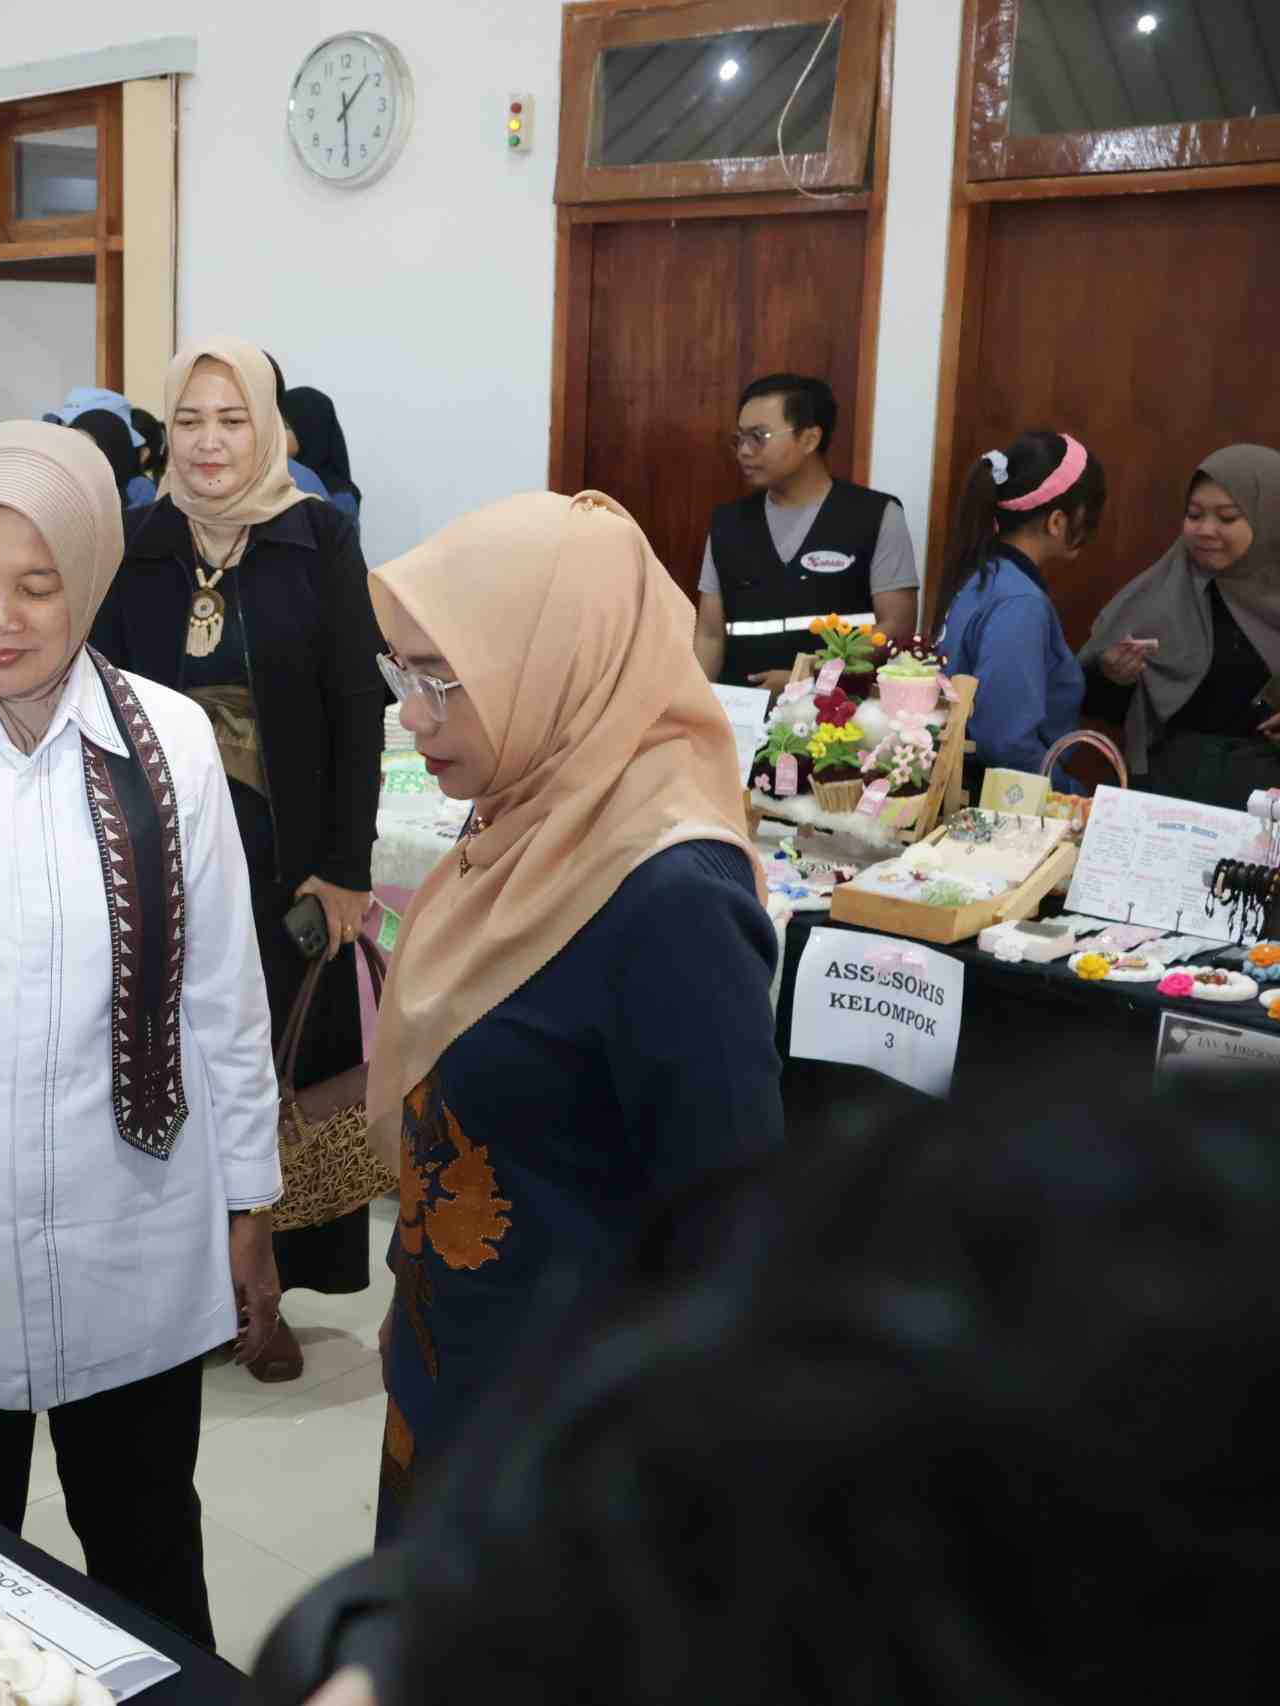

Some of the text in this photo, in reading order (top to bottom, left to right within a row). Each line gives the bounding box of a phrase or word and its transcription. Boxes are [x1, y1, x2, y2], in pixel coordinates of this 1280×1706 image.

[341, 53, 352, 69] 12
[324, 62, 333, 77] 11
[374, 72, 382, 88] 2
[310, 81, 321, 97] 10
[377, 96, 386, 112] 3
[306, 106, 315, 122] 9
[372, 123, 381, 138] 4
[312, 131, 320, 147] 8
[326, 147, 333, 164] 7
[359, 143, 368, 159] 5
[829, 992, 937, 1037] KELOMPOK
[884, 1032, 895, 1049] 3
